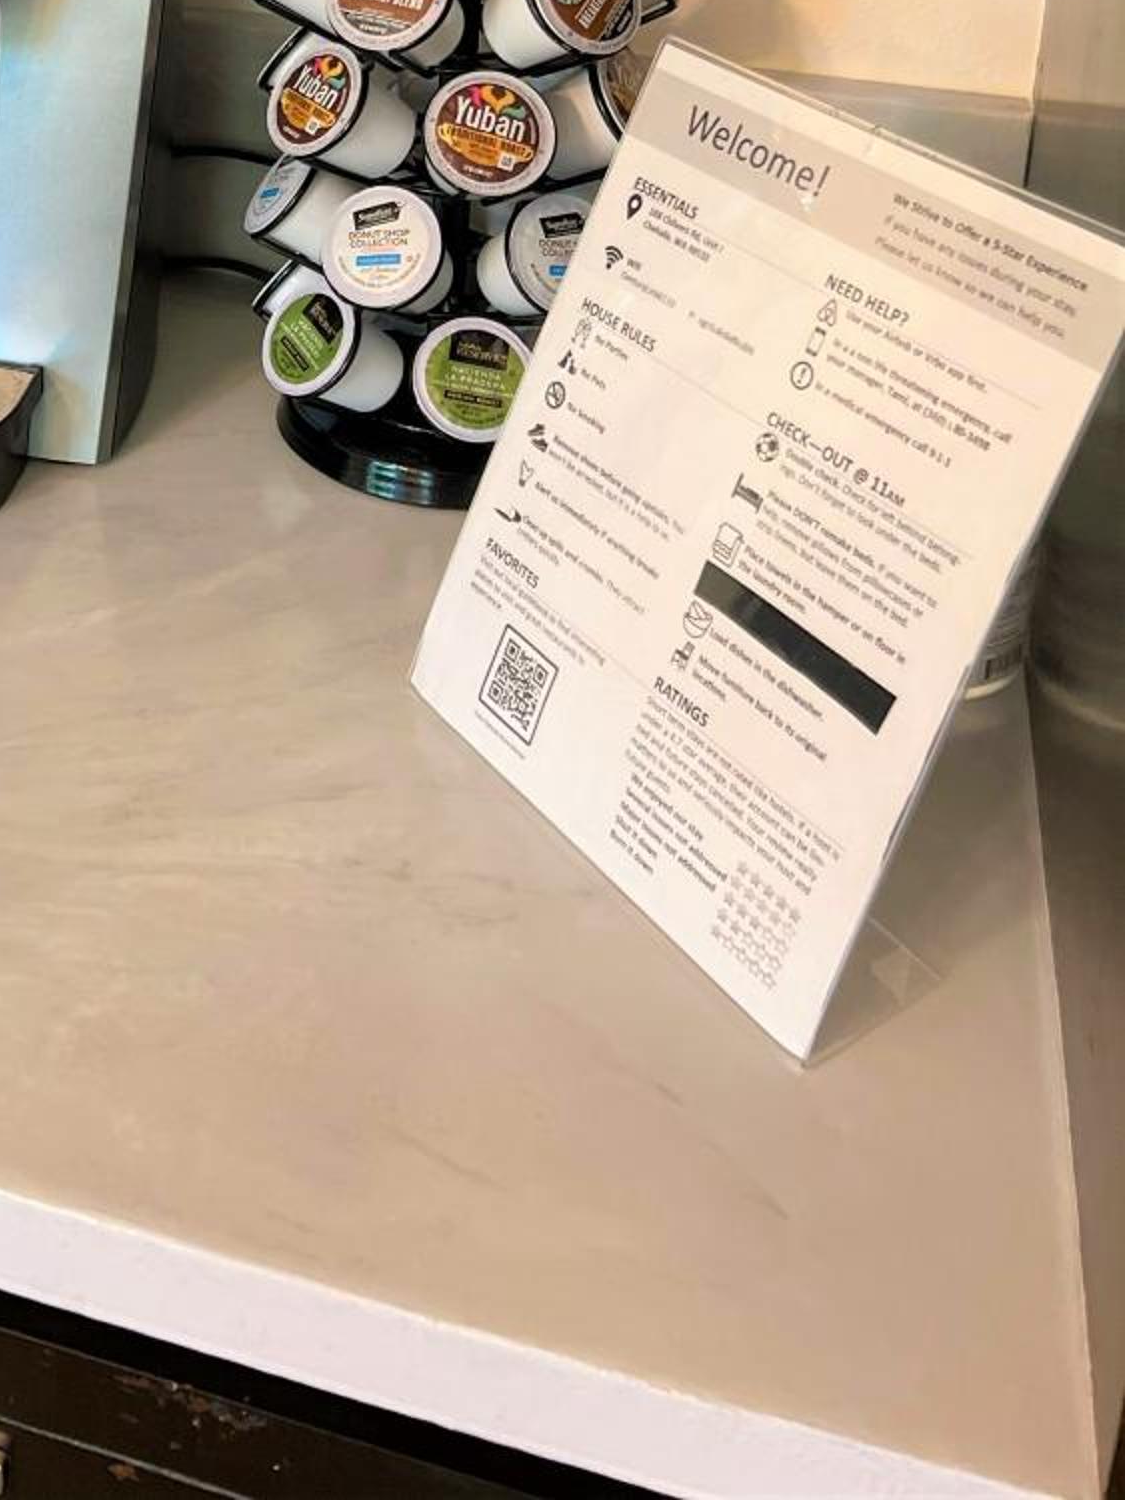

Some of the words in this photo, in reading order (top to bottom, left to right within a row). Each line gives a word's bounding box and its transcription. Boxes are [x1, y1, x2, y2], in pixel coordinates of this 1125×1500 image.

[292, 64, 339, 111] Yuban
[454, 95, 526, 143] Yuban
[683, 104, 830, 197] Welcome!
[633, 176, 698, 219] ESSENTIALS
[910, 202, 940, 222] Strive
[953, 222, 982, 241] Offer
[991, 239, 1025, 261] 5-Star
[1025, 254, 1089, 292] Experience
[580, 297, 620, 330] HOUSE
[619, 321, 656, 352] RULES
[824, 274, 863, 304] NEED
[864, 294, 910, 328] HELP?
[851, 464, 870, 487] @
[485, 536, 540, 589] FAVORITES
[653, 675, 710, 728] RATINGS
